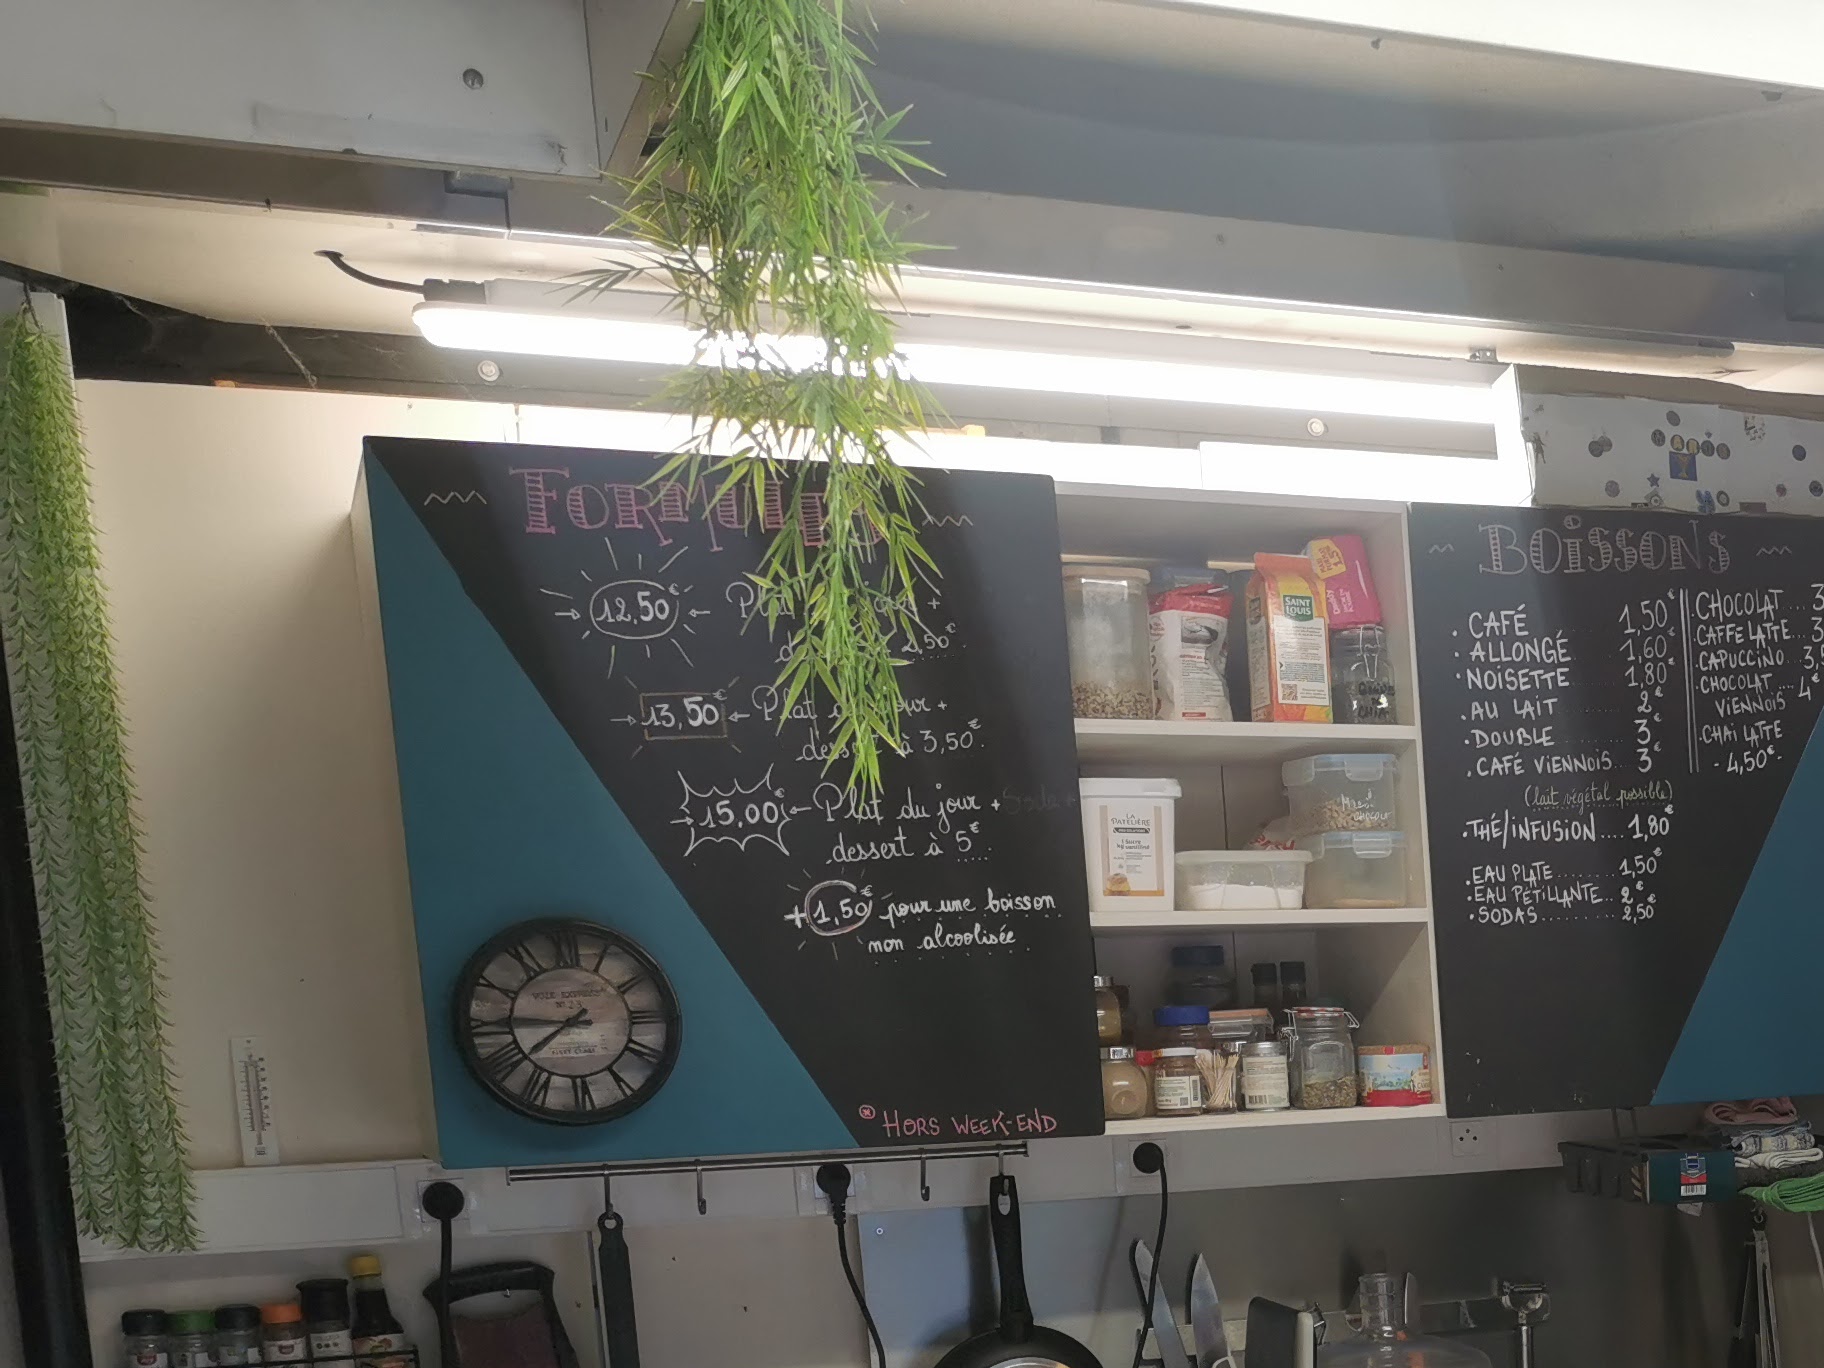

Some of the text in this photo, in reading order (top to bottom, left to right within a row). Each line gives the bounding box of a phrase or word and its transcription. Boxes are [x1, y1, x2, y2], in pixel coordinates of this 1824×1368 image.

[1285, 597, 1310, 607] SAINT
[1286, 605, 1312, 616] LOUIS
[1696, 588, 1783, 621] CHOCOLAT
[1468, 605, 1529, 638] CAFÉ
[1748, 622, 1792, 647] LATTE
[1469, 632, 1571, 664] ALLONGÉ
[1700, 672, 1773, 694] CHOCOLAT
[1471, 702, 1497, 721] AU
[1471, 725, 1556, 748] DOUBLE
[1744, 720, 1783, 742] LATTE
[1476, 752, 1525, 777] CAFÉ
[812, 782, 883, 827] Plat
[895, 800, 931, 821] du
[927, 783, 982, 834] jour
[826, 827, 915, 865] dessert
[924, 832, 944, 858] à
[1472, 863, 1506, 884] EAU
[1511, 861, 1554, 885] PLATE
[1474, 885, 1507, 903] EAU
[880, 898, 933, 928] pour
[938, 898, 977, 914] une
[984, 887, 1057, 914] boisson
[1477, 906, 1539, 925] SODAS
[868, 926, 1016, 954] non alcoolisée
[882, 1107, 1058, 1138] HORS WEEK-END
